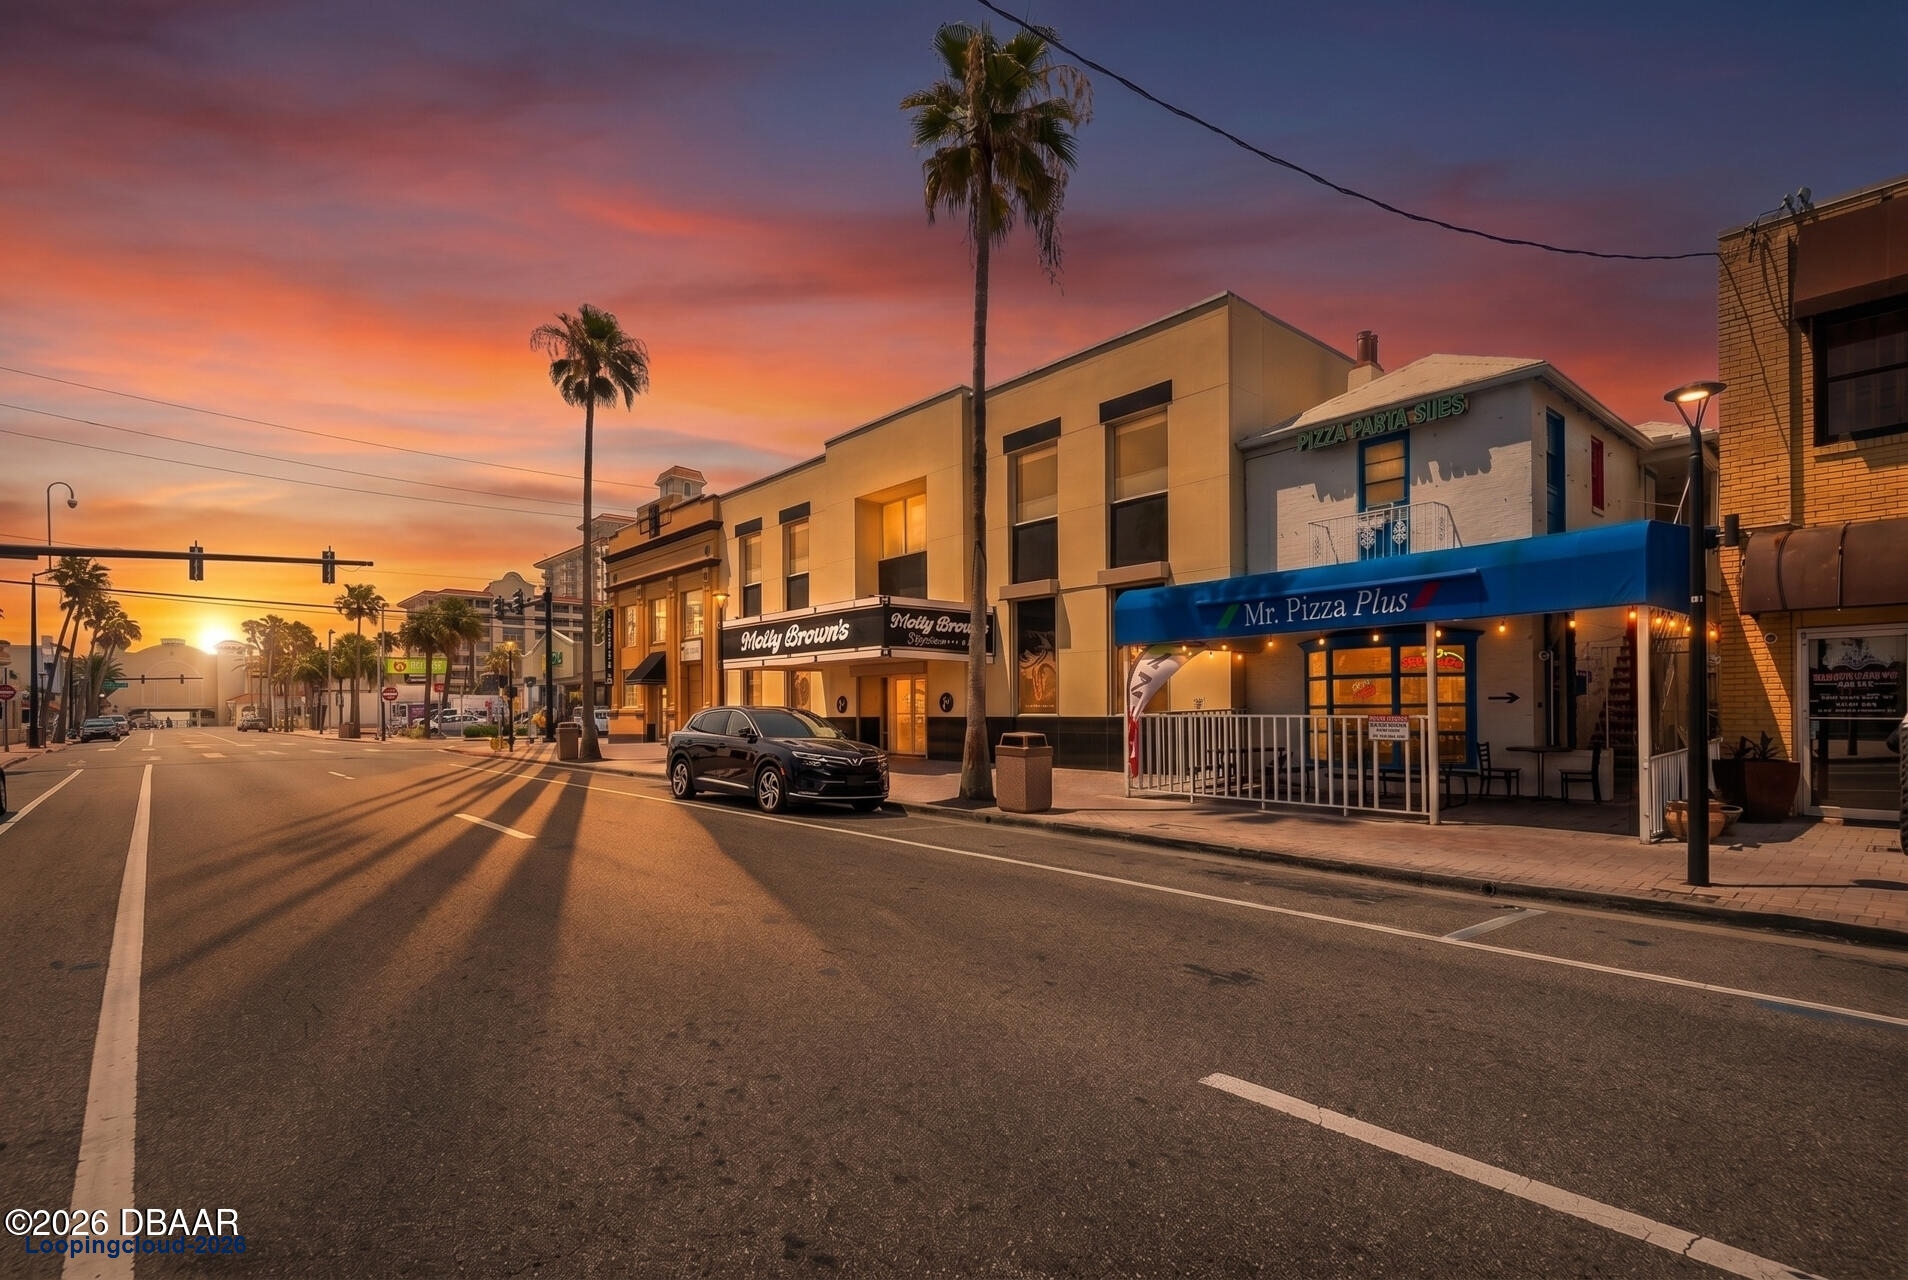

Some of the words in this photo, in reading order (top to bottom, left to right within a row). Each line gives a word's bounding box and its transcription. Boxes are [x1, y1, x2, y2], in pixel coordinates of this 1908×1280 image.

[1298, 424, 1347, 450] PIZZA
[1244, 602, 1279, 627] Mr.
[1286, 596, 1347, 623] Pizza
[1352, 587, 1408, 616] Plus
[741, 629, 783, 654] Molly
[784, 618, 850, 648] Brown's
[890, 612, 935, 635] Molly
